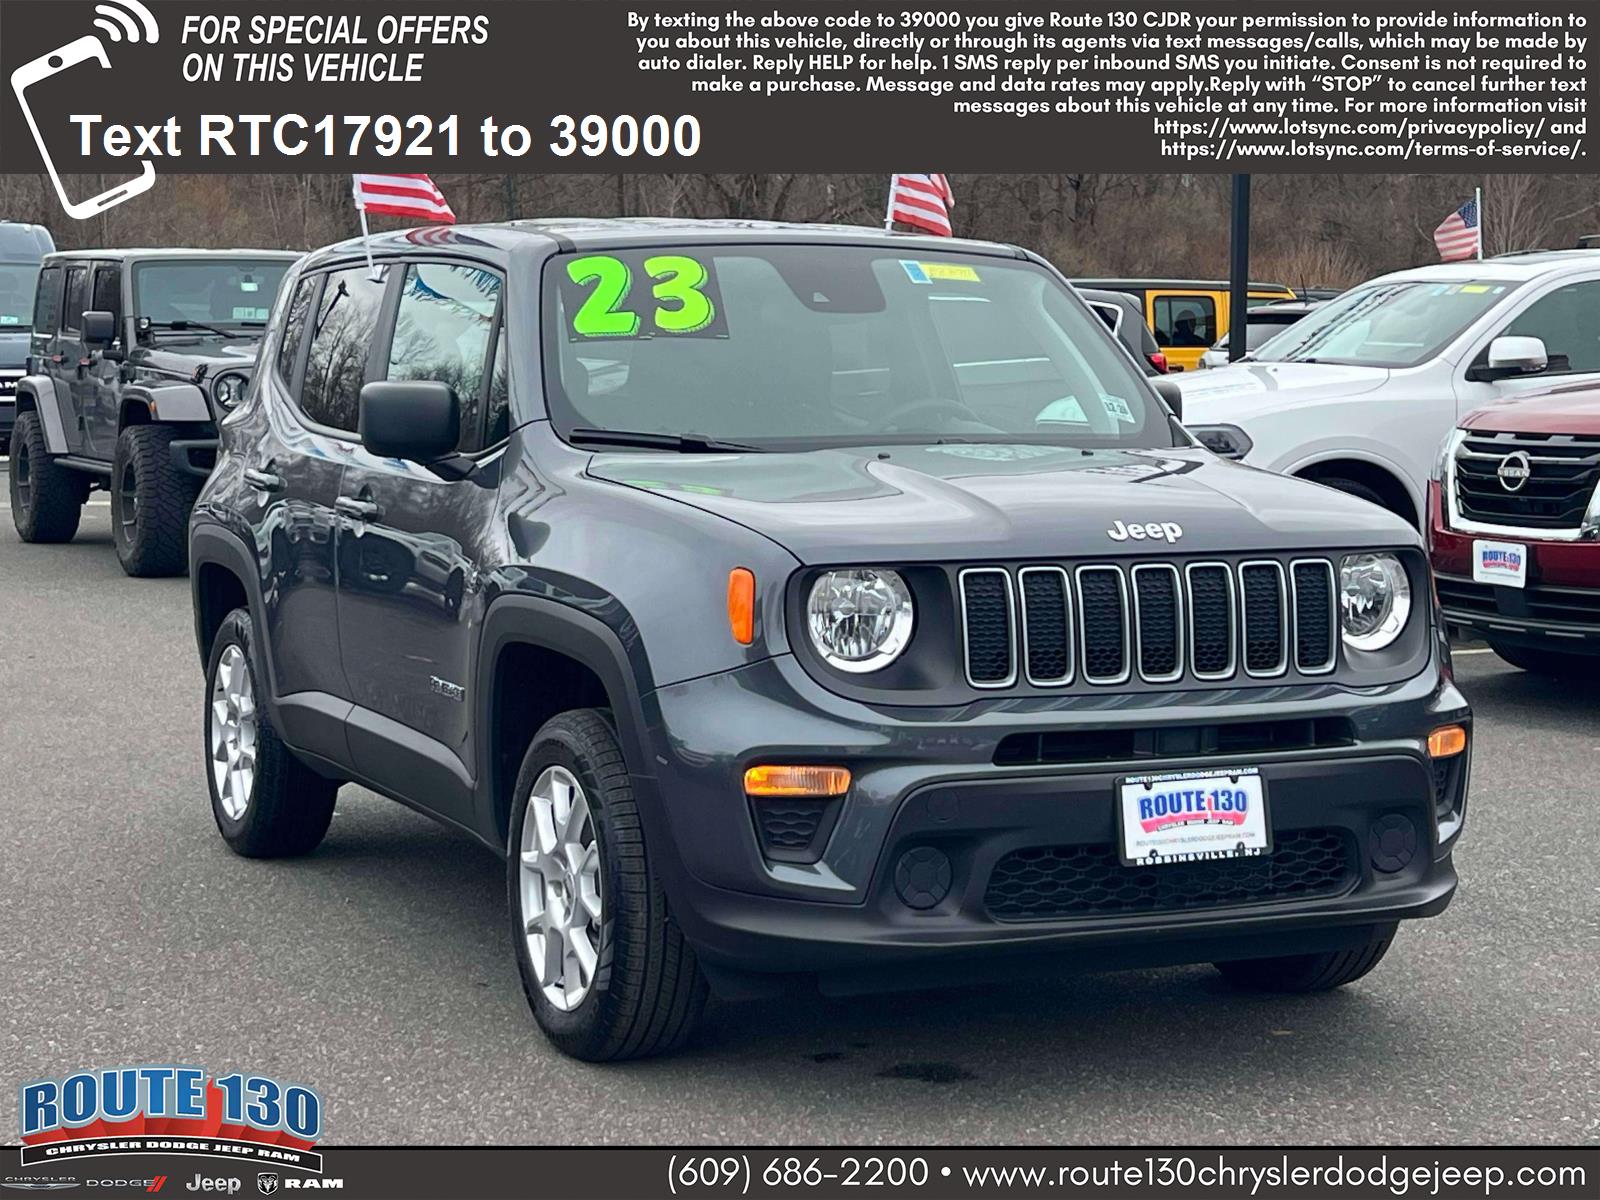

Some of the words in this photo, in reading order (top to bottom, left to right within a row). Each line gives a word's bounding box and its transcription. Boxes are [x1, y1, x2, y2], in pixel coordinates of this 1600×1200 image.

[567, 255, 715, 337] 23
[1107, 520, 1183, 544] Jeep
[1482, 550, 1507, 562] ROUTE
[1139, 791, 1206, 820] ROUTE
[1210, 789, 1248, 812] 130
[1244, 847, 1262, 857] NJ
